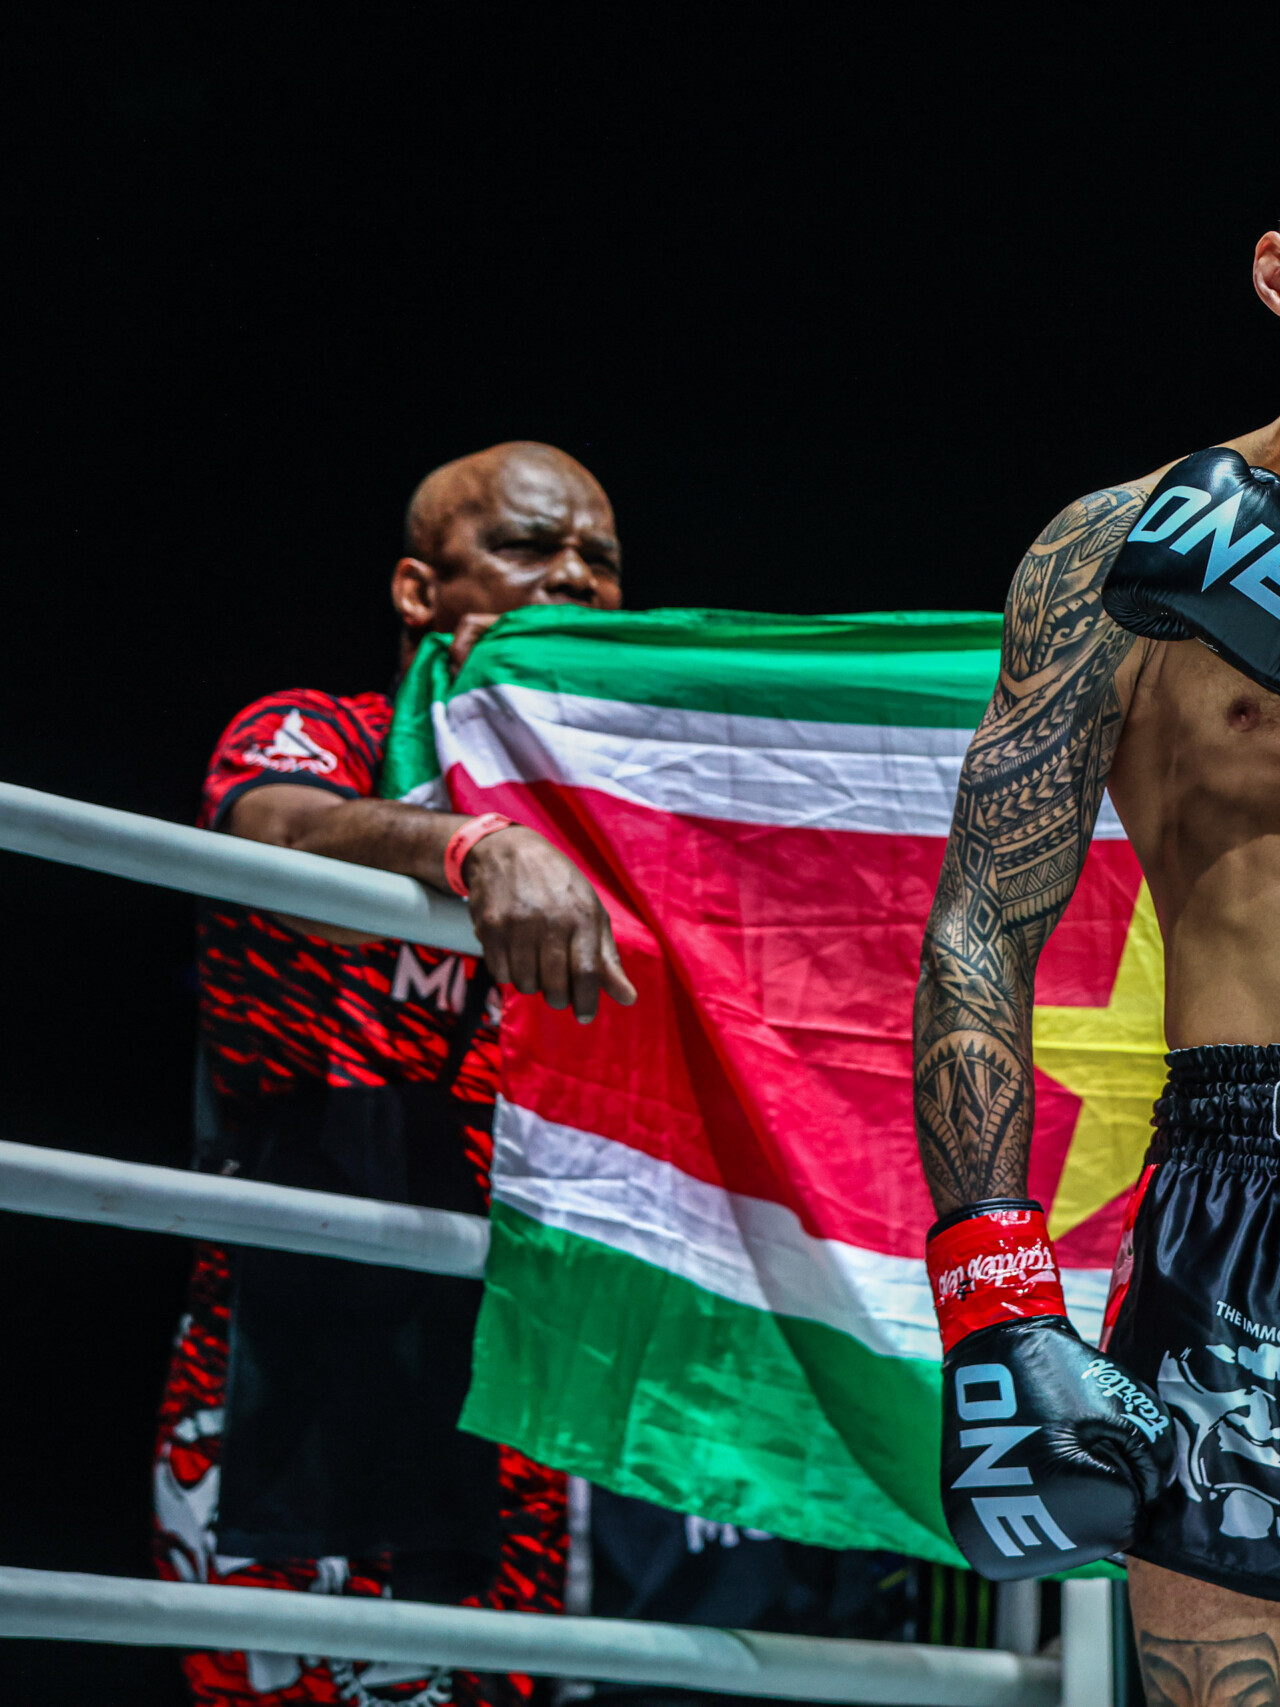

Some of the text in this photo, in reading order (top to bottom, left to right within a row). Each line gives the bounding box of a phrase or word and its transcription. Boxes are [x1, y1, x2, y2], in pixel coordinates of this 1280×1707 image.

[1216, 1300, 1242, 1326] THE
[1081, 1358, 1169, 1444] Fairtex
[951, 1363, 1077, 1557] ONE
